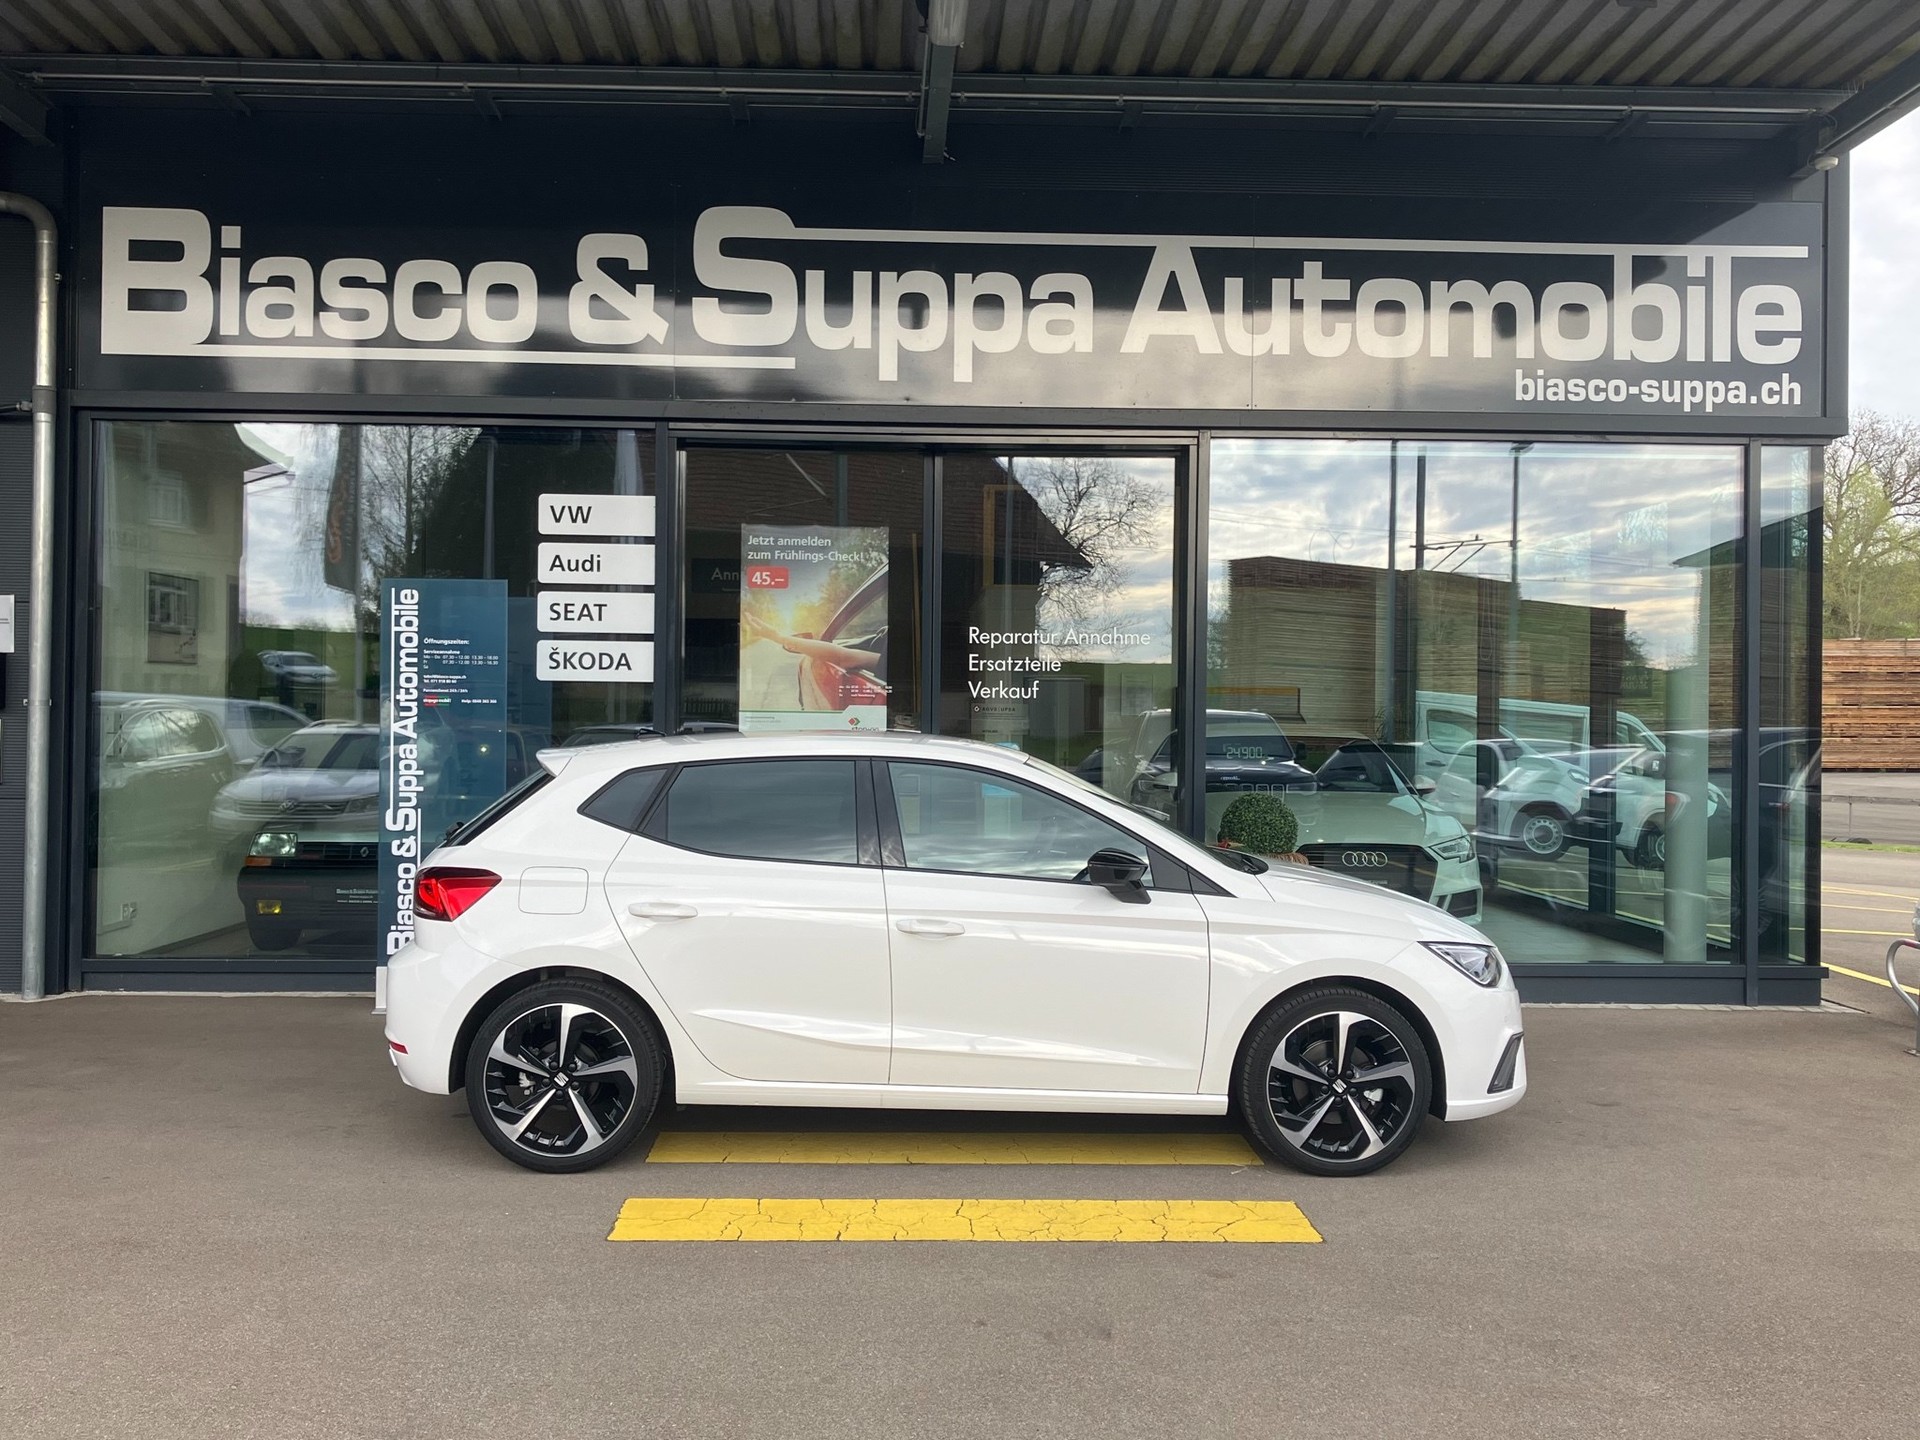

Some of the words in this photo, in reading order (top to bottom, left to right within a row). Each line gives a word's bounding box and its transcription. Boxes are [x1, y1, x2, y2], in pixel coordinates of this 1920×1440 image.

[101, 206, 538, 354] Biasco
[568, 233, 669, 345] &
[691, 206, 1094, 383] Suppa
[1119, 236, 1803, 365] Automobile
[1515, 368, 1803, 413] biasco-suppa.ch
[549, 505, 593, 524] VW
[747, 535, 775, 546] Jetzt
[777, 535, 832, 547] anmelden
[549, 554, 602, 573] Audi
[747, 551, 771, 560] zum
[774, 550, 864, 563] Frühlings-Check!
[711, 567, 740, 581] Ann
[549, 602, 608, 622] SEAT
[423, 637, 470, 646] Öffnungszeiten:
[968, 626, 1059, 649] Reparatur
[1063, 626, 1152, 646] Annahme
[391, 588, 420, 740] Automobile
[548, 646, 633, 671] ŠKODA
[968, 653, 1063, 673] Ersatzteile
[967, 680, 1040, 700] Verkauf
[385, 743, 425, 832] Suppa
[391, 835, 417, 858] &
